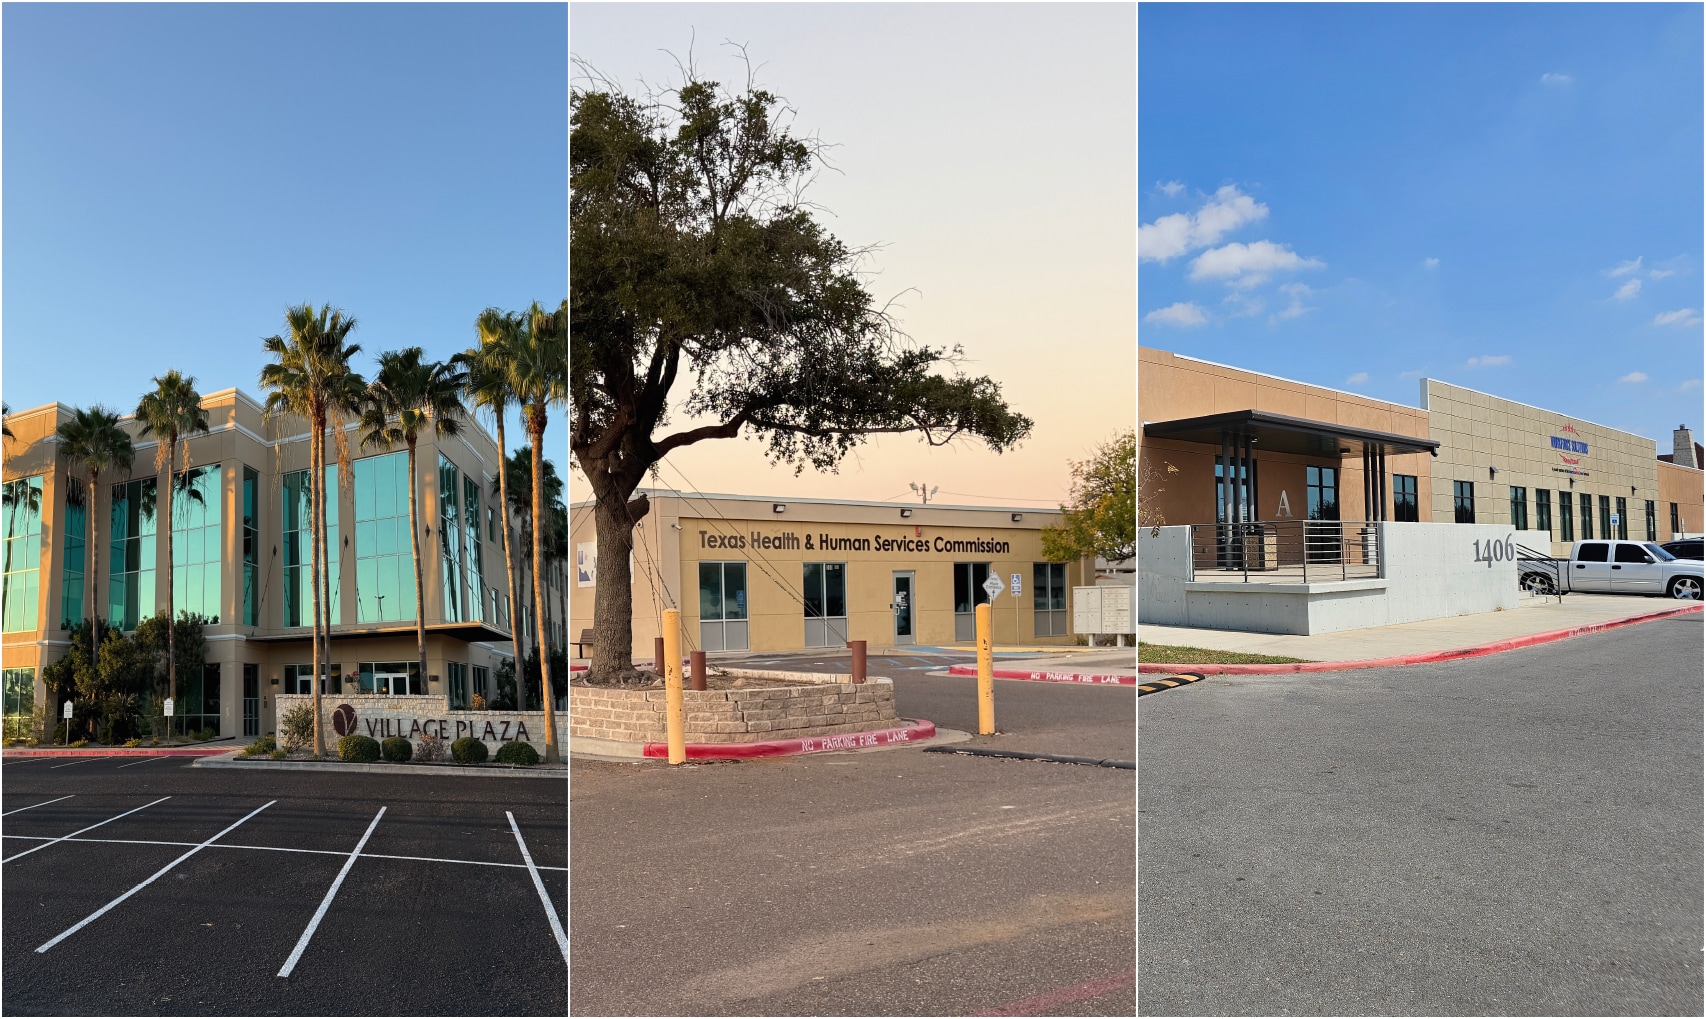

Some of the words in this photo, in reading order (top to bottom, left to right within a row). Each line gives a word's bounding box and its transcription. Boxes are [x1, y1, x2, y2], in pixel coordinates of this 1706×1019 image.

[1275, 489, 1294, 518] A
[698, 530, 746, 549] Texas
[750, 531, 800, 550] Health
[804, 533, 815, 550] &
[819, 533, 871, 551] Human
[874, 534, 930, 553] Services
[933, 536, 1010, 554] Commission
[1473, 533, 1515, 569] 1406
[1030, 672, 1041, 680] NO
[1046, 673, 1074, 682] PARKING
[1078, 674, 1094, 683] FIRE
[1101, 675, 1121, 684] LANE
[365, 718, 450, 739] VILLAGE
[455, 720, 531, 742] PLAZA
[801, 739, 814, 752] NO
[821, 735, 857, 750] PARKING
[859, 733, 878, 747] FIRE
[886, 730, 910, 743] LANE
